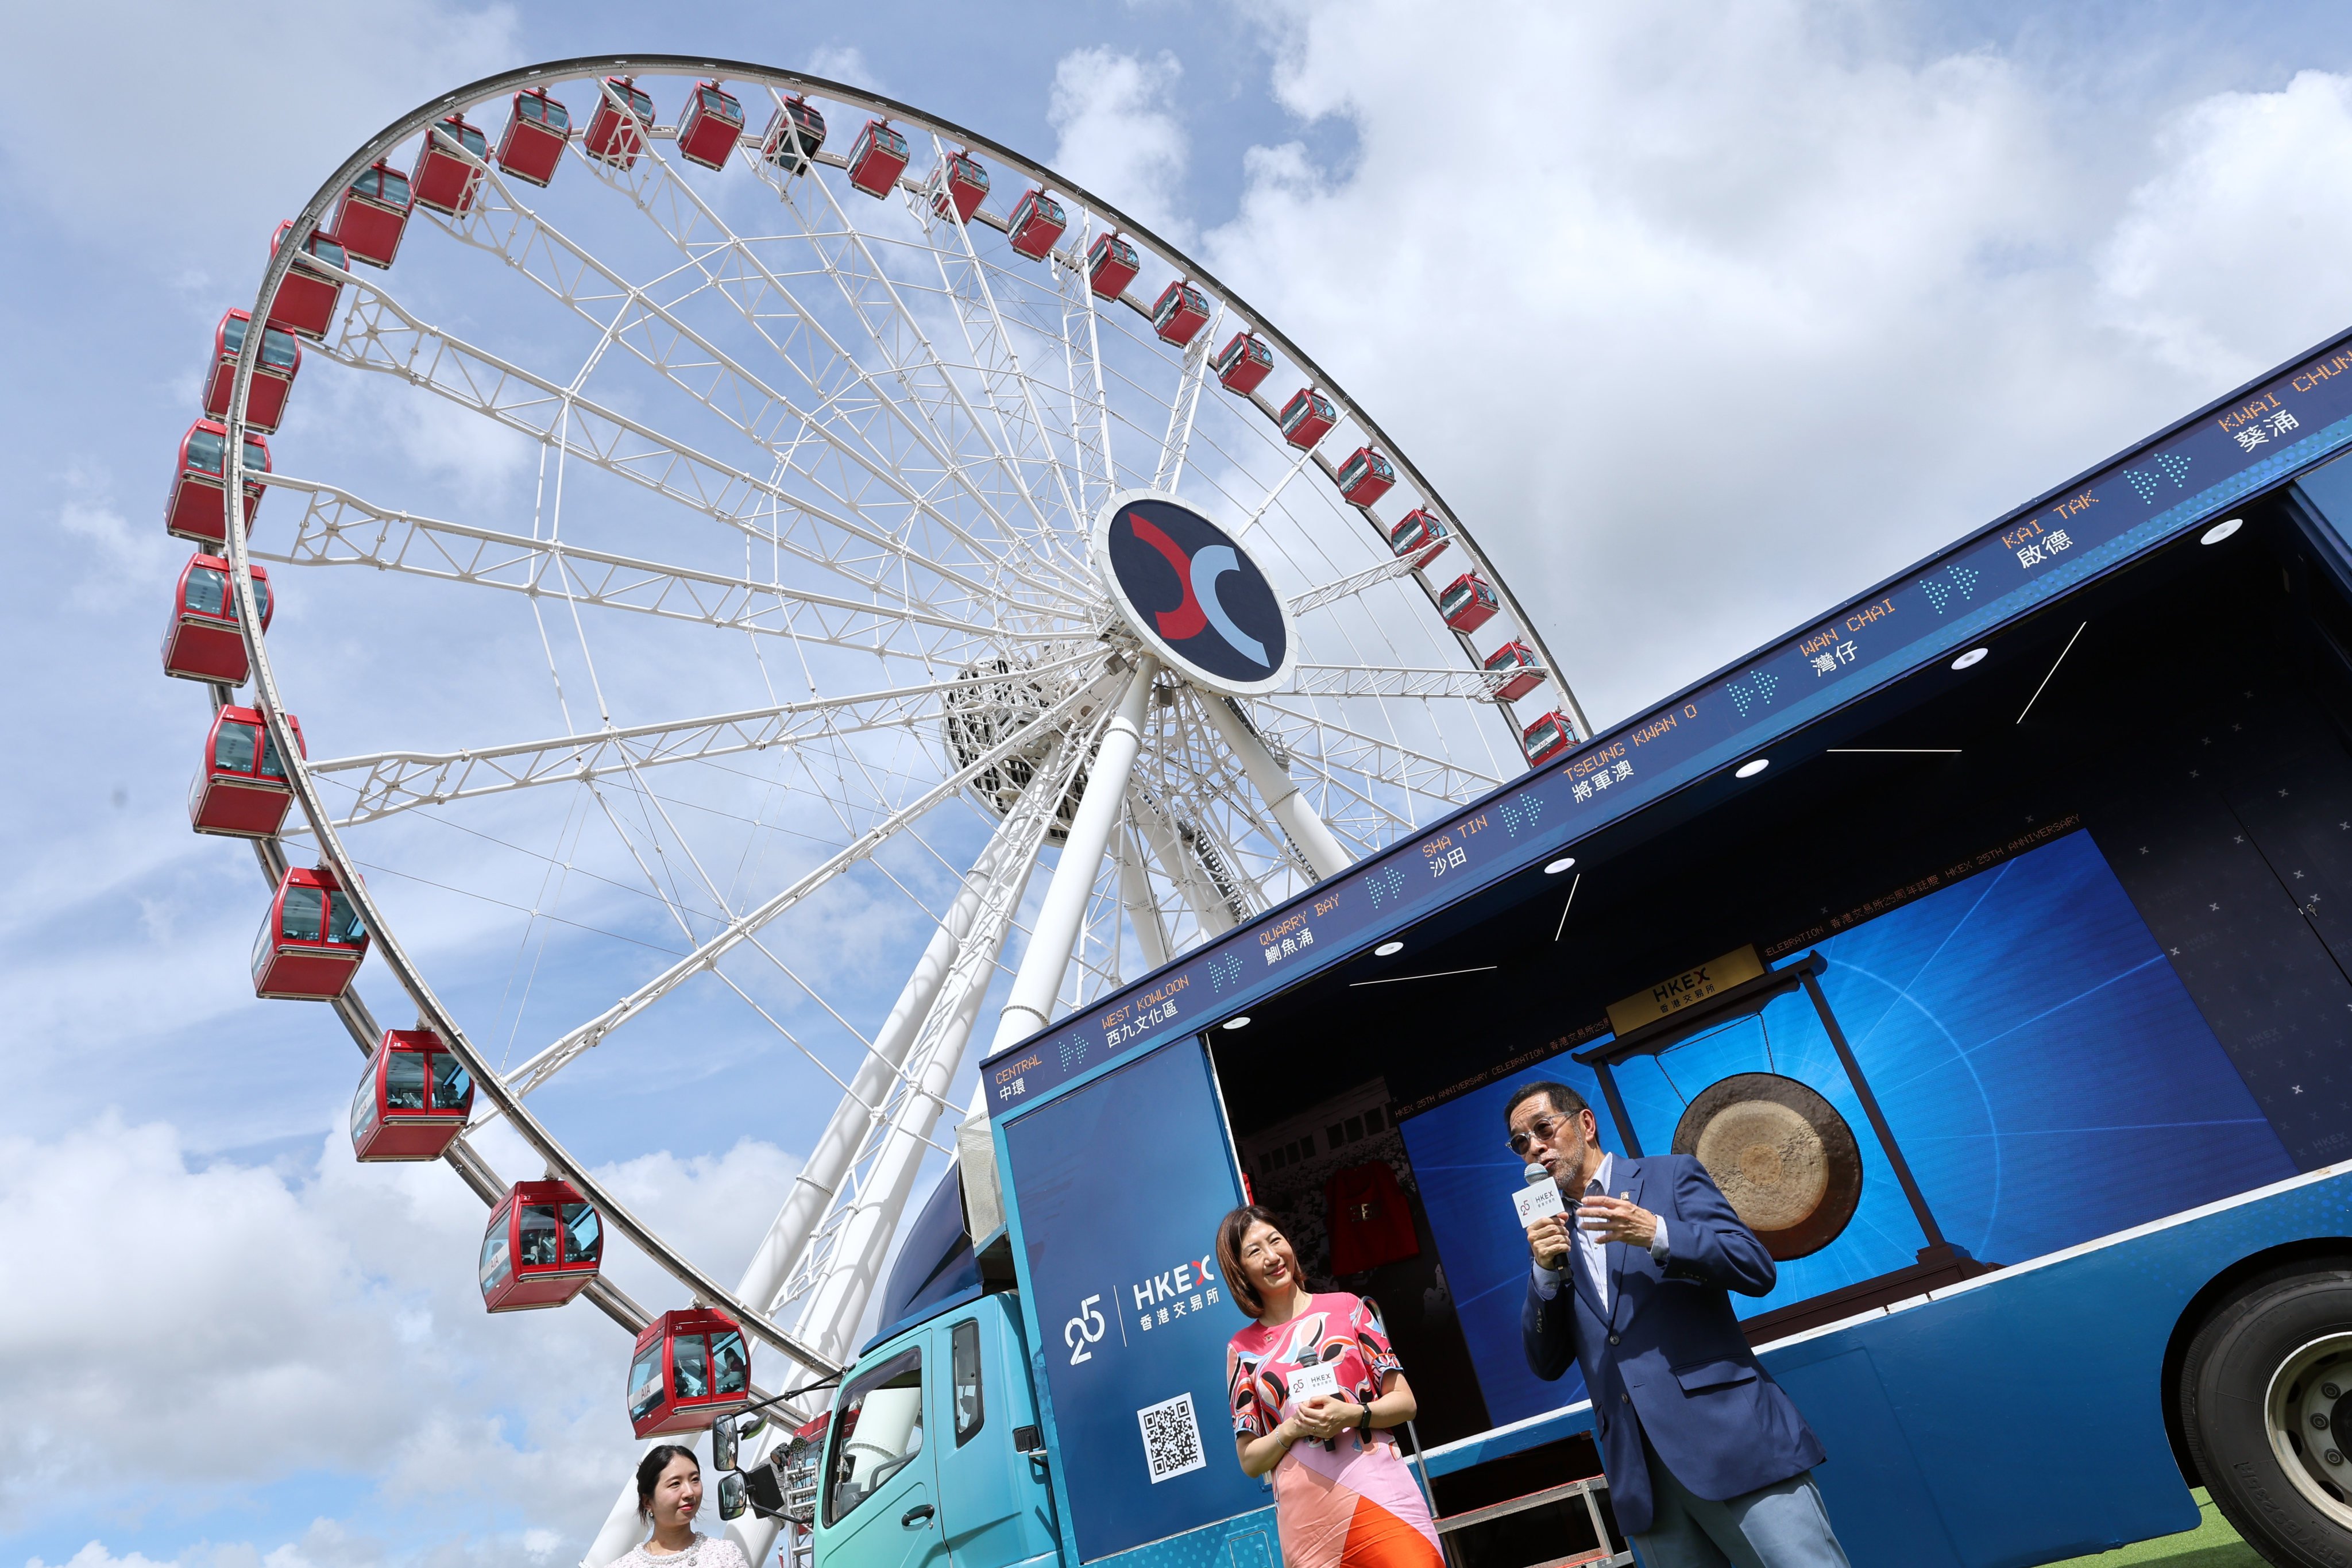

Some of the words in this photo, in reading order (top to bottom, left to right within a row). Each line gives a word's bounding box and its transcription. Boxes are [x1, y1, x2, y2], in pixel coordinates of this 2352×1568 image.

[1291, 414, 1299, 423] AIA
[2218, 392, 2281, 432] KWAI
[2233, 410, 2299, 453] 葵涌
[2001, 519, 2045, 549] KAI
[2053, 489, 2099, 519] TAK
[1404, 534, 1412, 543] AIA
[2016, 529, 2073, 569] 啟德
[1454, 599, 1462, 608] AIA
[1799, 628, 1839, 657] WAN
[1846, 598, 1896, 633] CHAI
[1810, 640, 1859, 677] 灣仔
[1539, 739, 1548, 748] AIA
[1563, 742, 1625, 781] TSEUNG
[1632, 714, 1677, 747] KWAN
[1683, 704, 1698, 719] O
[1571, 759, 1635, 804] 將軍澳
[1422, 835, 1453, 859] SHA
[1458, 814, 1489, 839] TIN
[1429, 847, 1467, 878] 沙田
[1764, 925, 1824, 957] ELEBRATION
[1945, 860, 1972, 878] HKEX
[1976, 847, 2004, 865] 25TH
[2008, 813, 2081, 852] ANNIVERSARY
[1260, 911, 1307, 946] QUARRY
[1314, 893, 1339, 917] BAY
[1265, 928, 1314, 966] 鰂魚涌
[1102, 1006, 1131, 1030] WEST
[1137, 975, 1189, 1011] KOWLOON
[1652, 967, 1710, 1003] HKEX
[1659, 983, 1716, 1014] 香港交易所
[1106, 999, 1178, 1048] 西九文化區
[995, 1054, 1042, 1084] CENTRAL
[1395, 1104, 1414, 1118] HKEX
[1416, 1094, 1436, 1109] 25TH
[1438, 1071, 1488, 1099] ANNIVERSARY
[1492, 1047, 1544, 1076] CELEBRATION
[999, 1077, 1026, 1102] 中環
[2312, 1131, 2349, 1149] HKEX
[1520, 1199, 1530, 1216] 25
[1535, 1190, 1554, 1203] HKEX
[490, 1256, 499, 1271] AIA
[1133, 1254, 1215, 1310] HKEX
[1140, 1287, 1219, 1331] 香港交易所
[1065, 1294, 1106, 1365] 25
[640, 1387, 651, 1399] AIA
[1293, 1379, 1304, 1393] 25
[1311, 1373, 1331, 1383] HKEX
